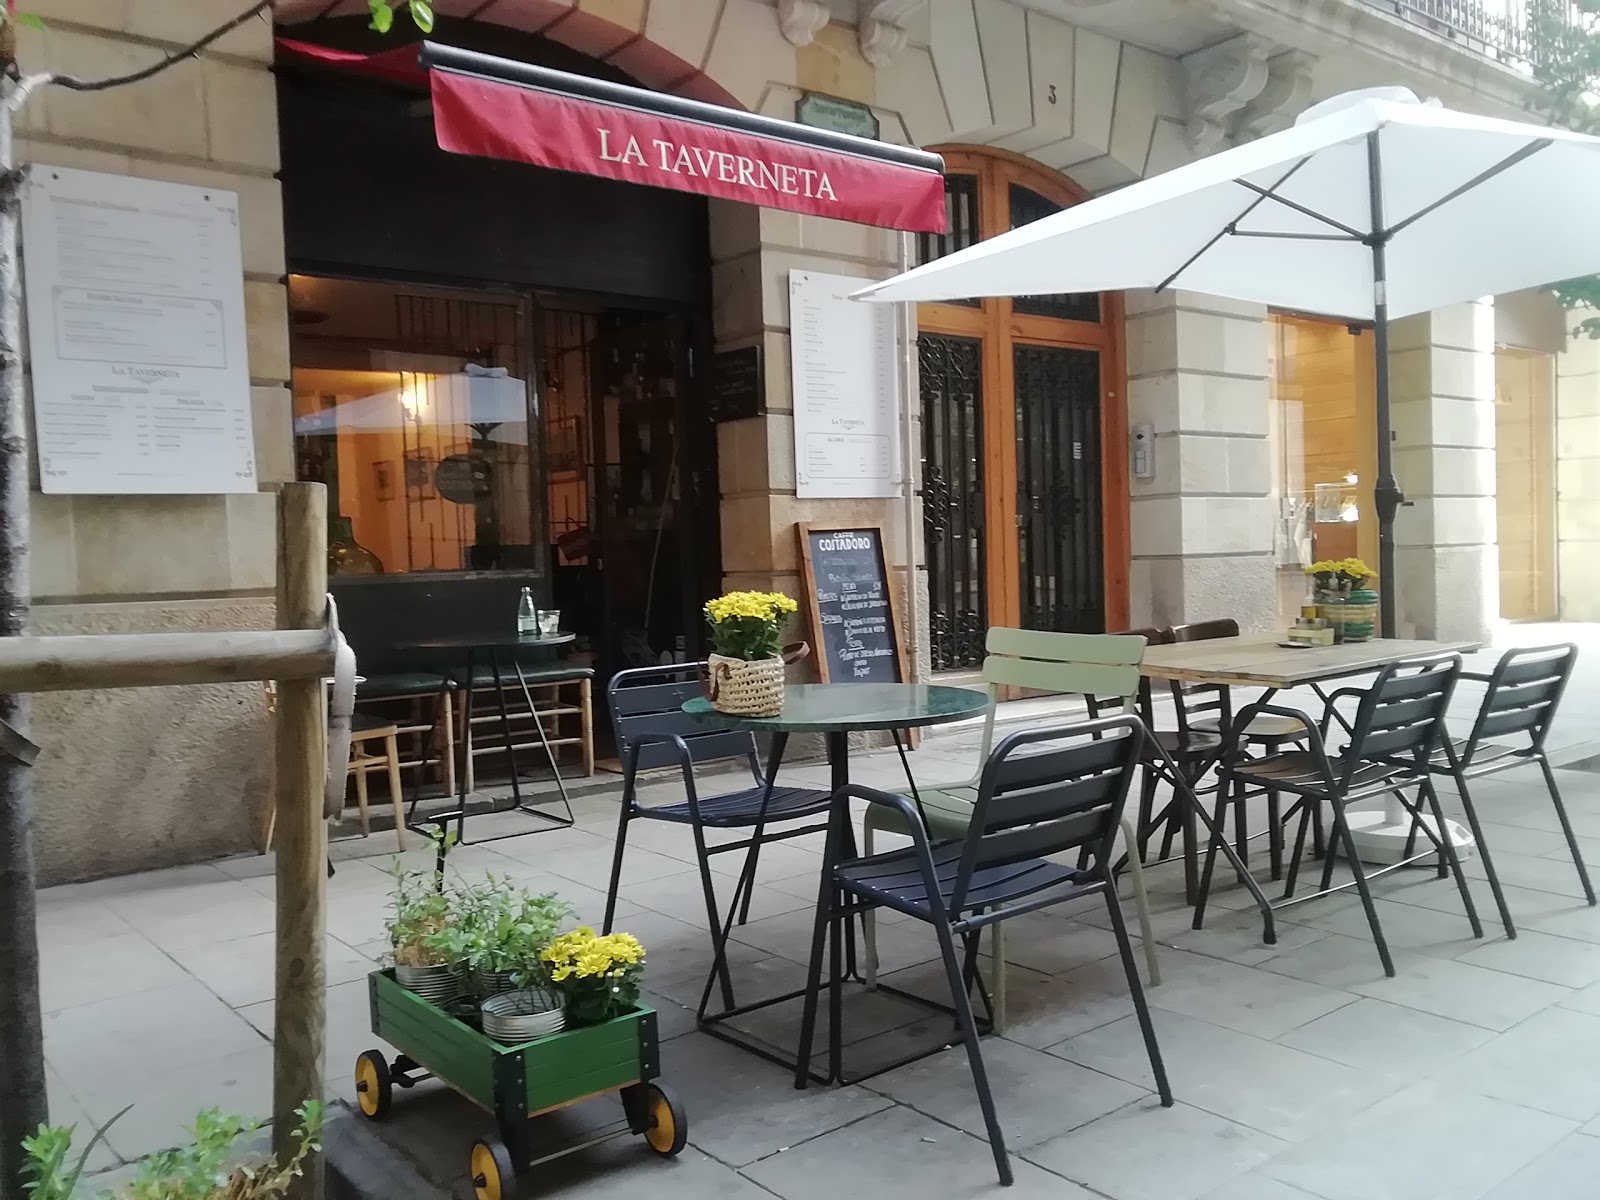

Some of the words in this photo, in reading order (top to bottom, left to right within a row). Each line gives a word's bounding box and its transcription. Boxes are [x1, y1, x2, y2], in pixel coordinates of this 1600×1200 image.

[1048, 84, 1057, 105] 3
[597, 128, 649, 167] LA
[652, 139, 839, 202] TAVERNETA
[819, 538, 871, 551] COSTADORO
